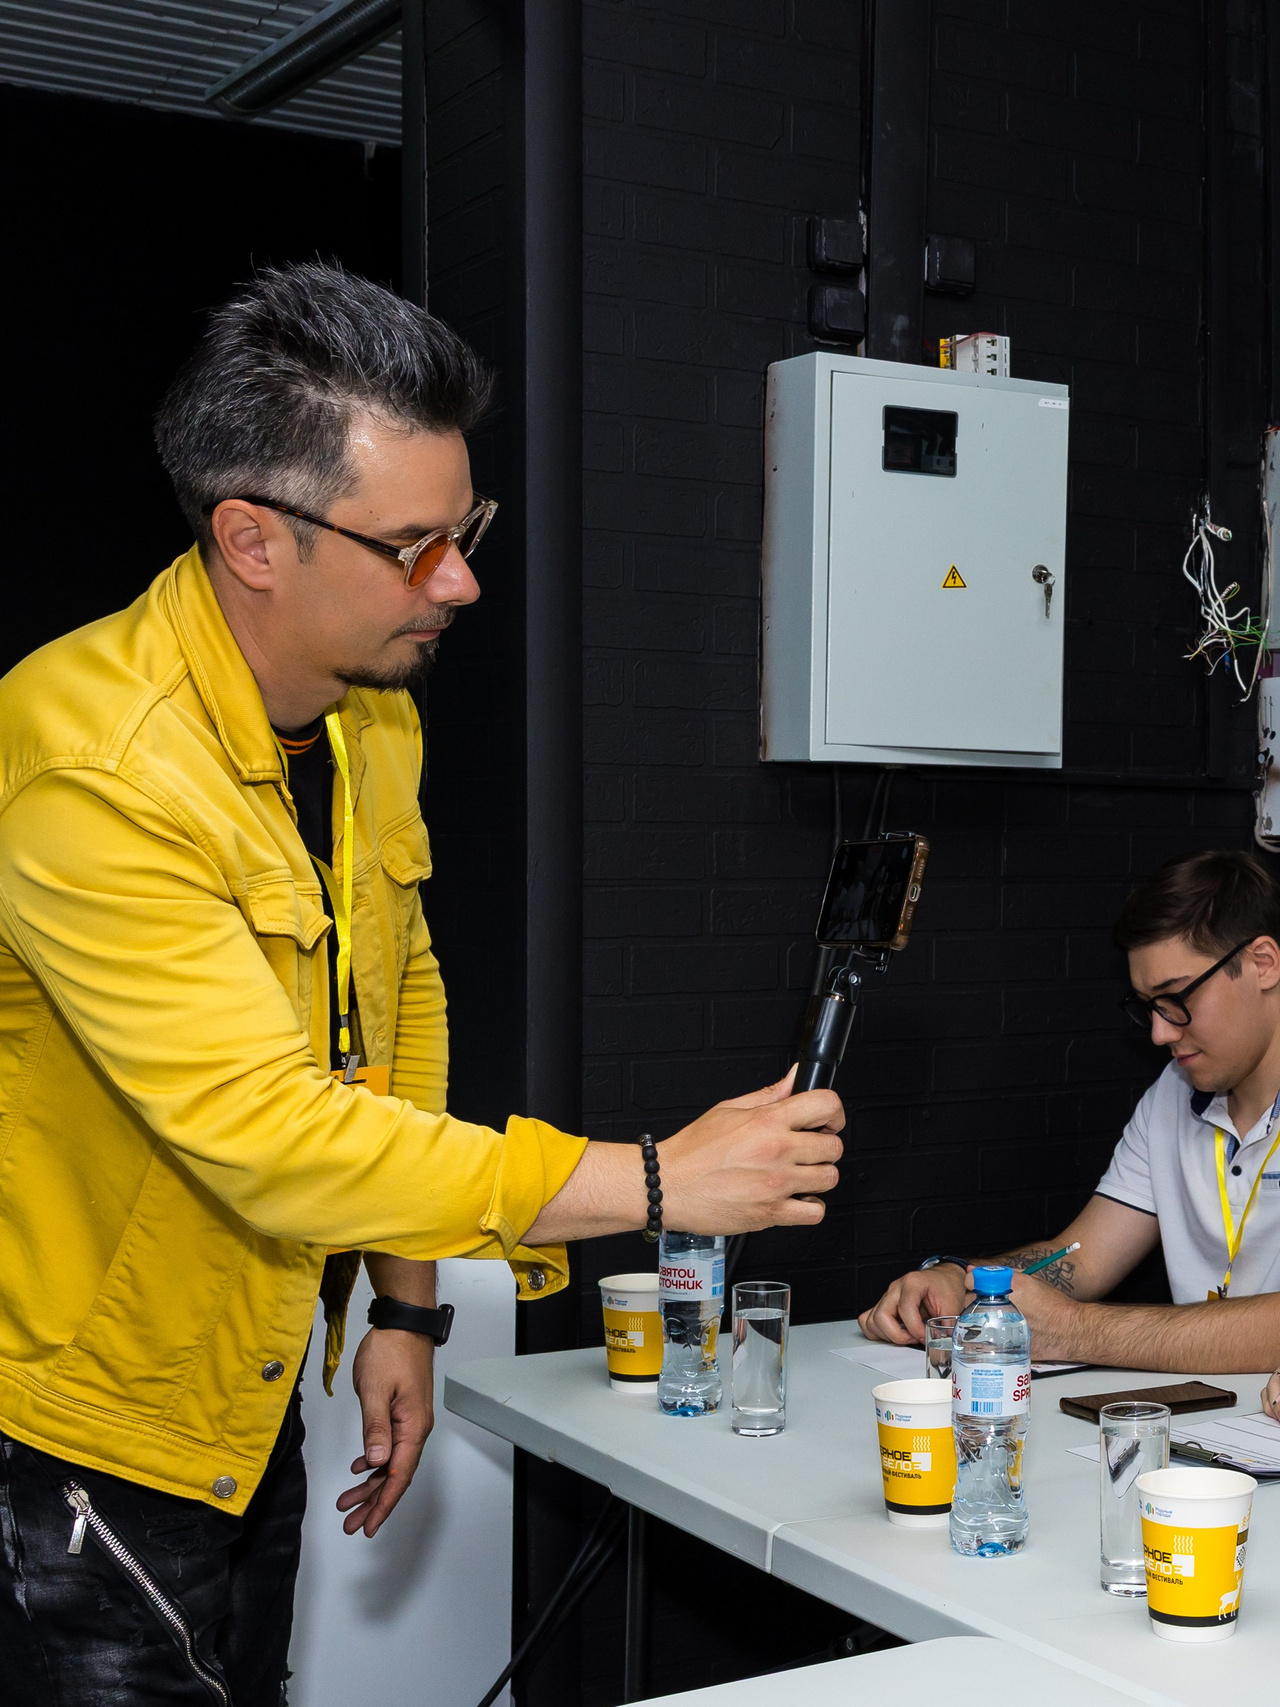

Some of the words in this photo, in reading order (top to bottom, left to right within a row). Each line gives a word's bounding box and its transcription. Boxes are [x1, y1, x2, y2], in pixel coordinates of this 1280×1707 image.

[660, 1278, 703, 1290] ТОЧНИК
[892, 1471, 922, 1479] ФЕСТИВАЛЬ
[1152, 1573, 1183, 1585] ФЕСТИВАЛЬ
